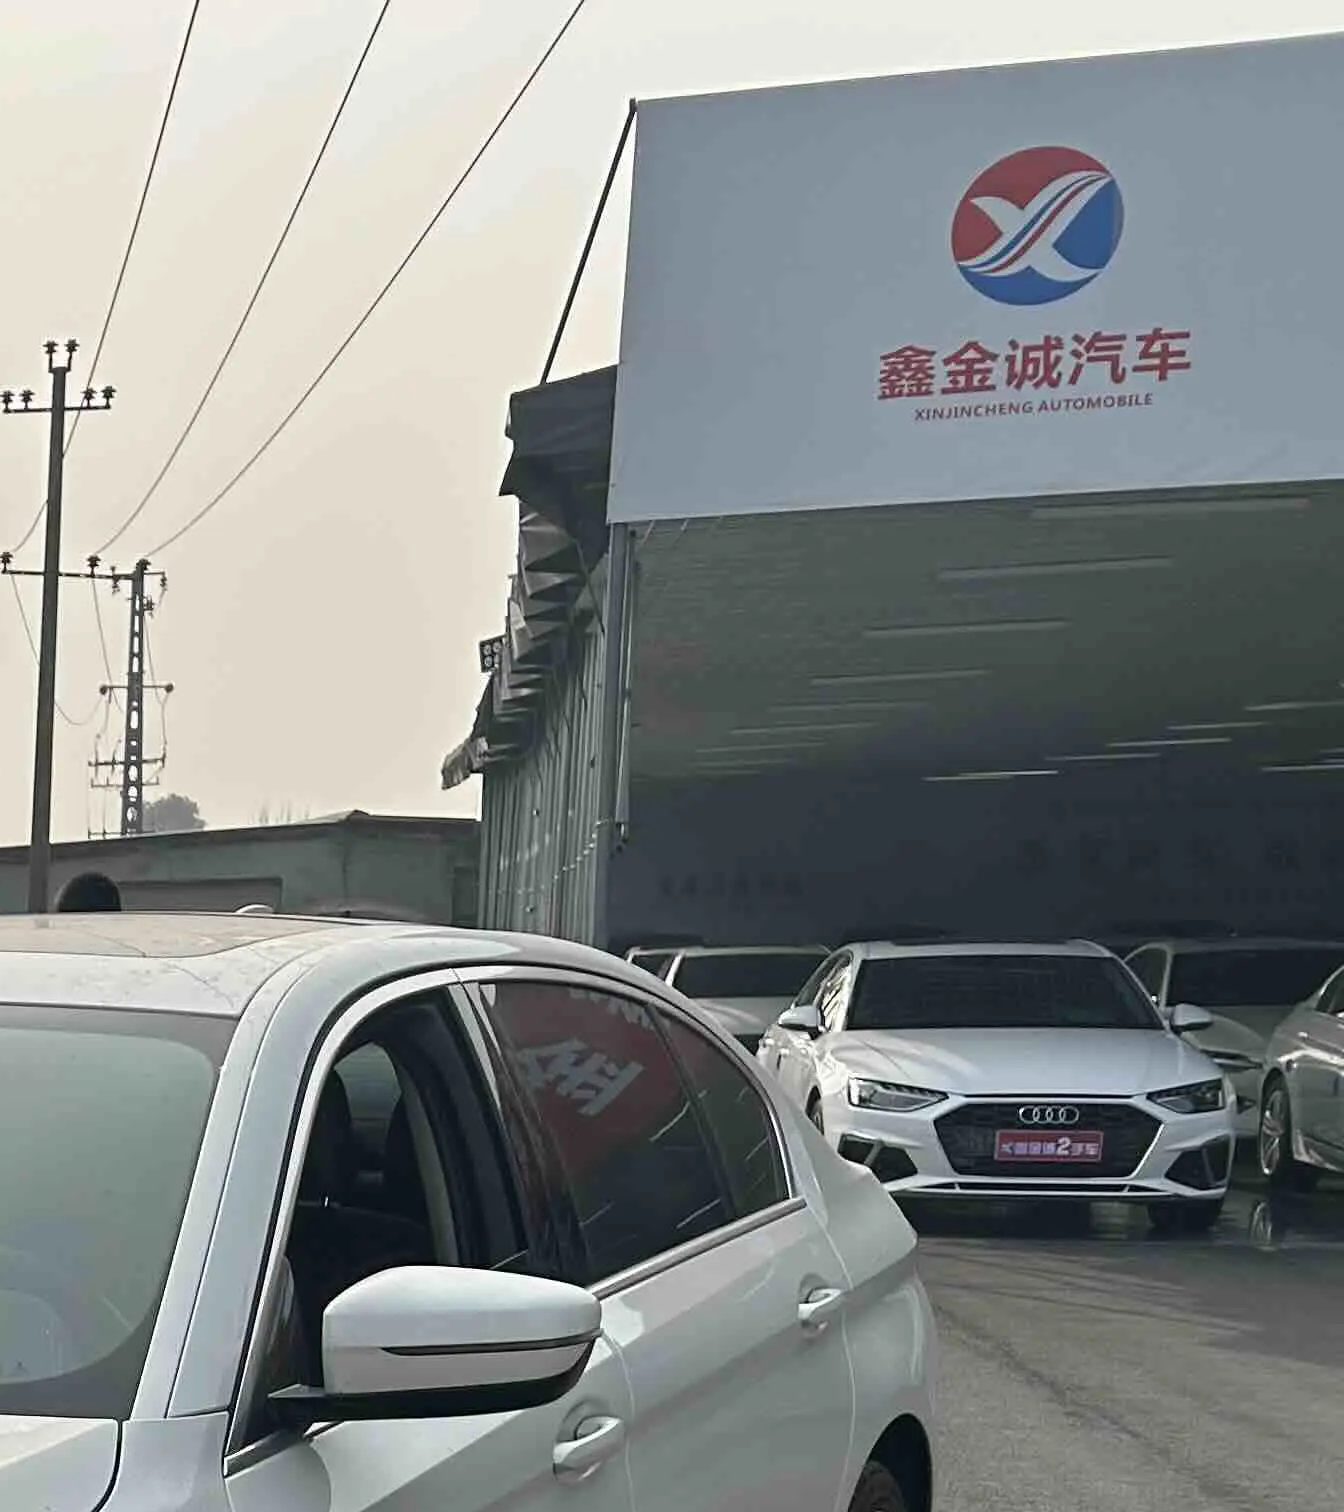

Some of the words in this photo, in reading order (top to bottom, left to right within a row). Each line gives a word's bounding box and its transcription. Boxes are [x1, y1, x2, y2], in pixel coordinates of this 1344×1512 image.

[877, 327, 1191, 401] 鑫金诚汽车
[913, 400, 1034, 422] XINJINCHENG
[1037, 393, 1153, 414] AUTOMOBILE
